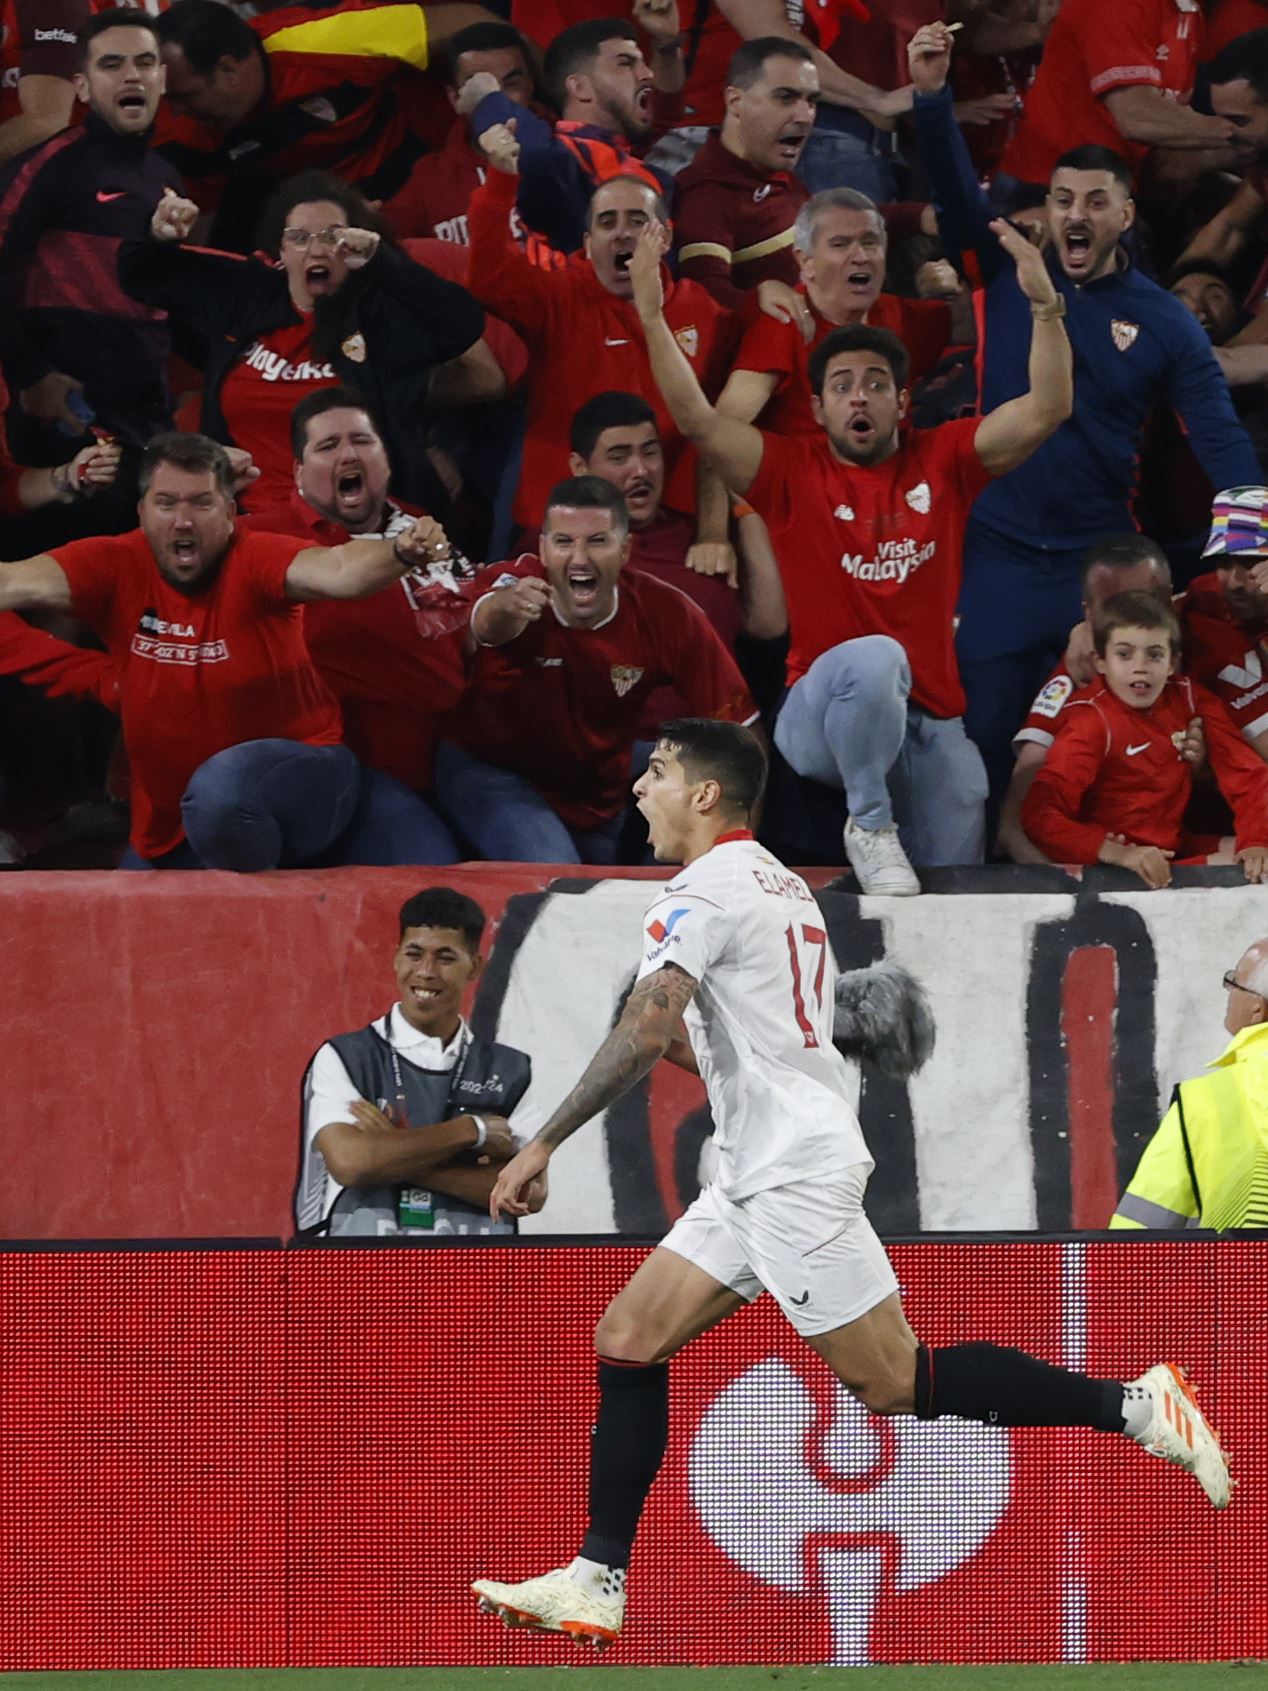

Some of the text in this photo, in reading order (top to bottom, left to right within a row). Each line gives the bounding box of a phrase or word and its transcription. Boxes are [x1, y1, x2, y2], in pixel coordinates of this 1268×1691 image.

[841, 541, 936, 583] Malaysia
[877, 537, 917, 559] Visit
[784, 921, 827, 1049] 17
